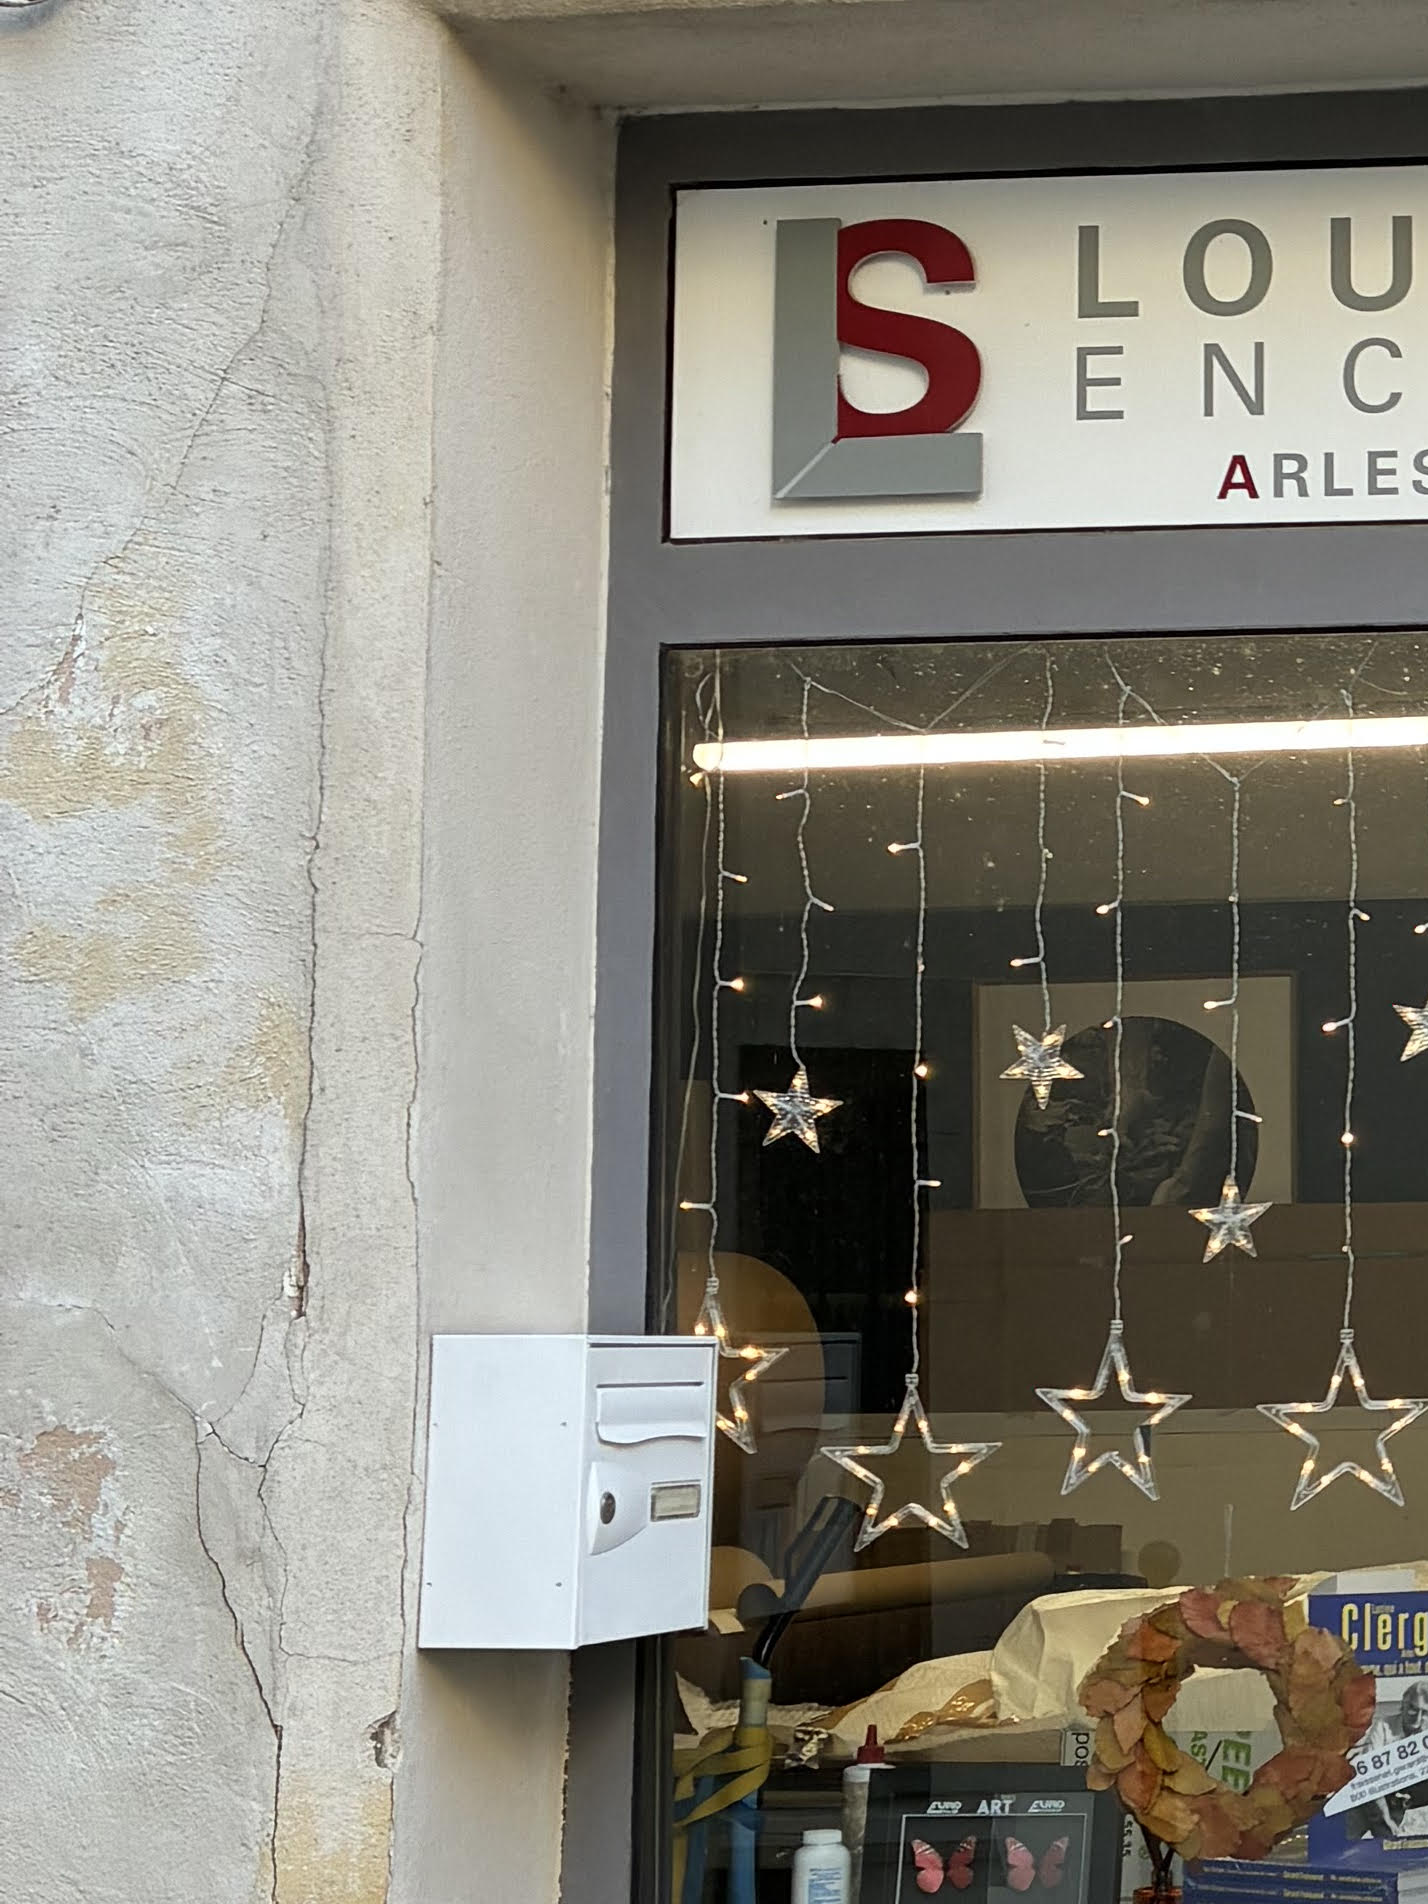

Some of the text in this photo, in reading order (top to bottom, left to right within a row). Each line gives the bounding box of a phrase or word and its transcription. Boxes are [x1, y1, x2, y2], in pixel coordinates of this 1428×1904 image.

[1371, 1750, 1391, 1770] 87
[1396, 1740, 1420, 1760] 82
[976, 1799, 1013, 1815] ART
